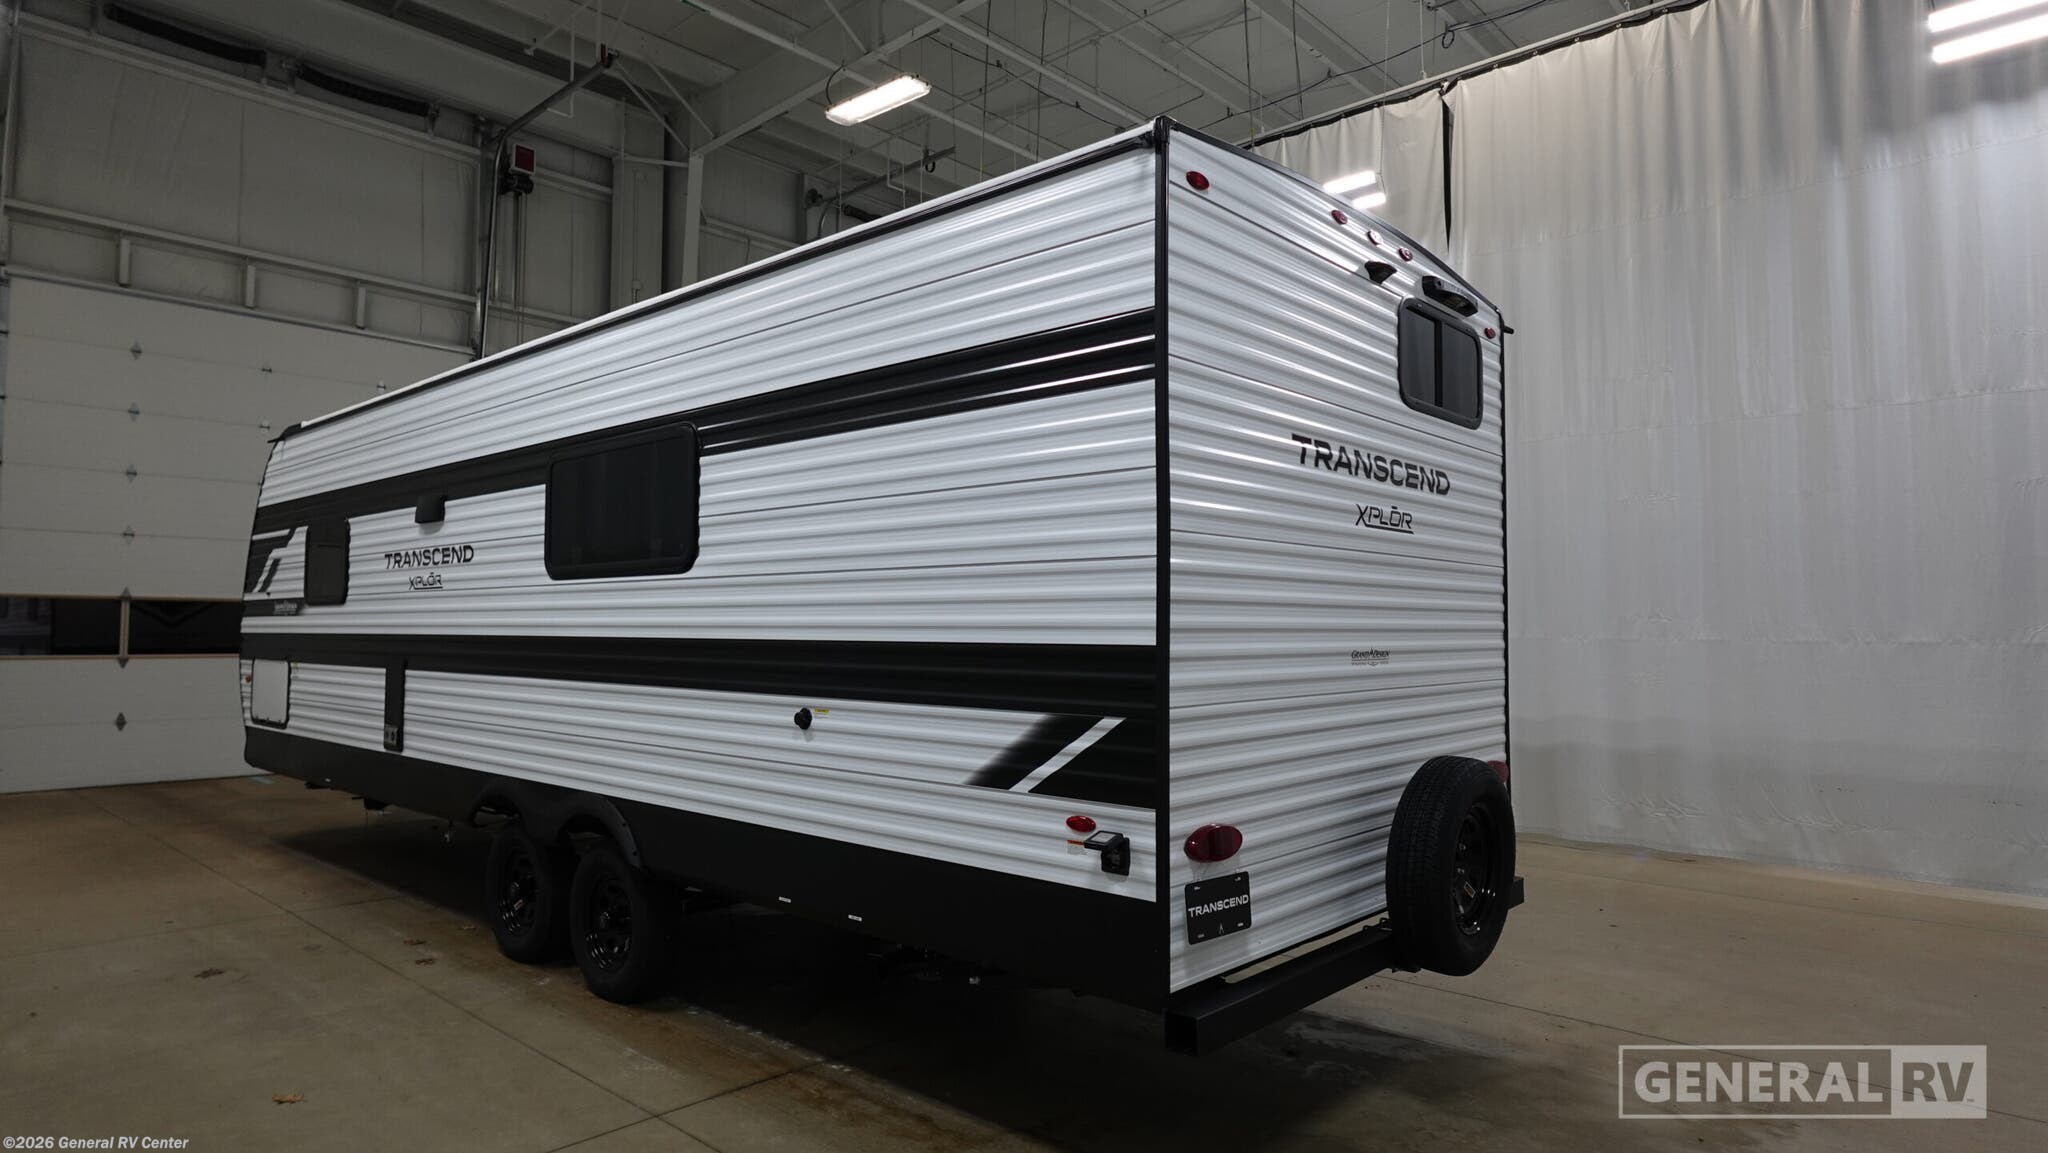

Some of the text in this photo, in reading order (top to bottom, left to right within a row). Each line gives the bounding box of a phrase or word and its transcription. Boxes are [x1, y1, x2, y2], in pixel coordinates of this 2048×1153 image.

[1292, 433, 1451, 495] TRANSCEND
[384, 544, 474, 569] TRANSCEND
[1187, 894, 1250, 918] TRANSCEND
